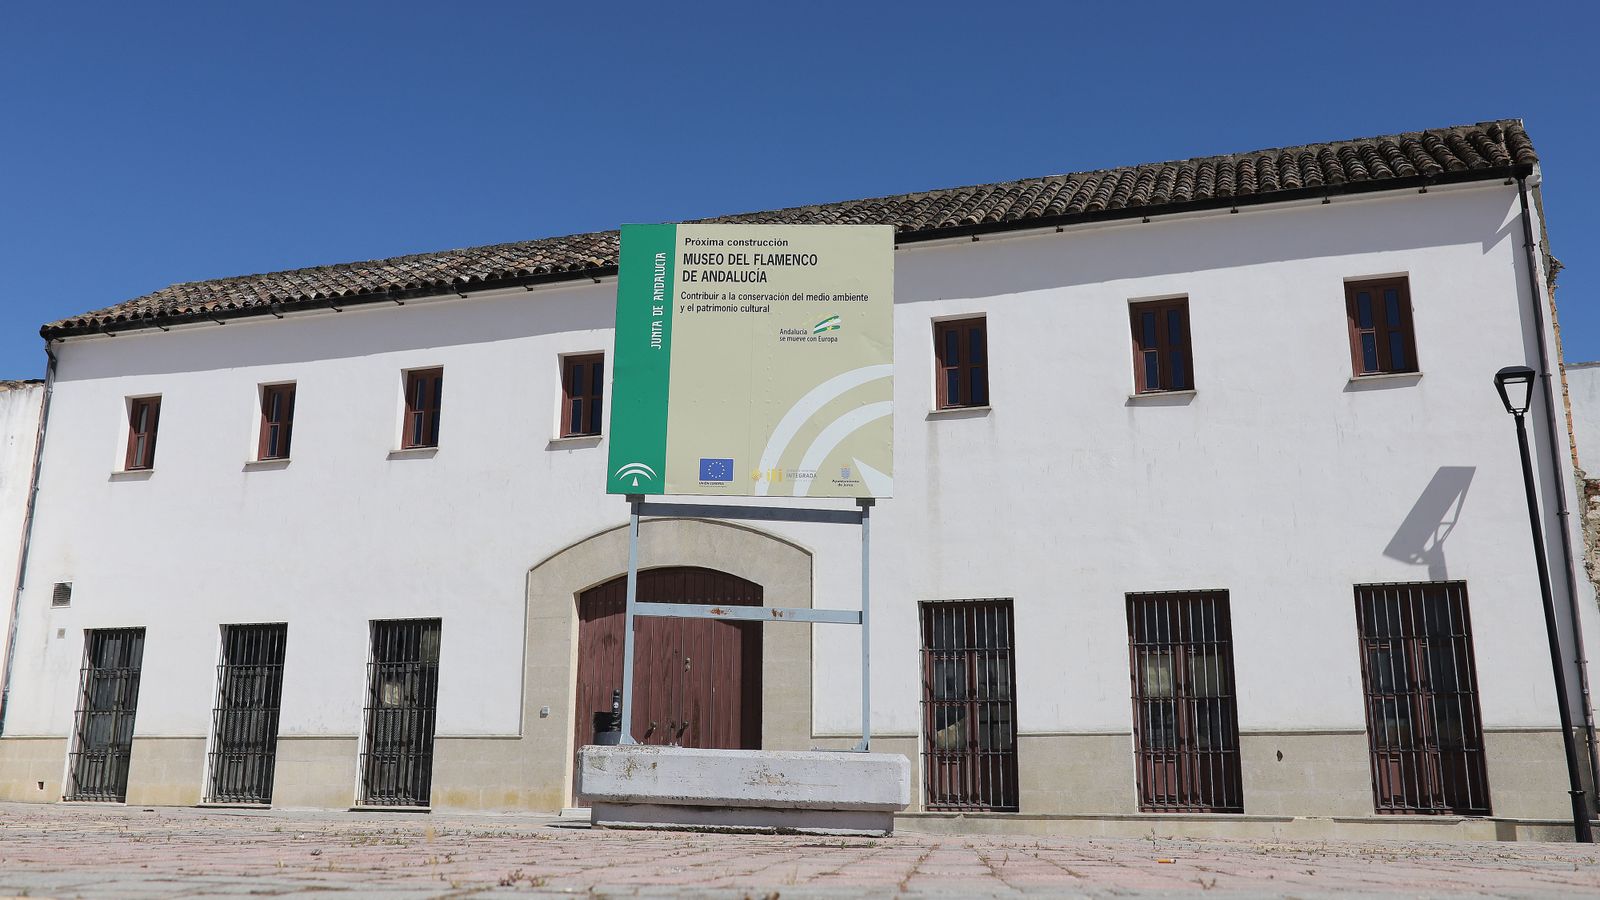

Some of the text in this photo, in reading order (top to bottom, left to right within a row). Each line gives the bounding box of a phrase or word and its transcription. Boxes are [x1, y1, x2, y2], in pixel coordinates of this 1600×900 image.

[685, 237, 789, 247] Próxima construcción
[683, 253, 818, 266] MUSEO DEL FLAMENCO
[682, 268, 767, 282] DE ANDALUCÍA
[680, 291, 719, 301] Contribuir
[729, 292, 736, 301] la
[738, 292, 790, 301] conservación
[791, 292, 804, 301] del
[806, 293, 831, 302] medio
[832, 293, 869, 302] ambiente
[652, 305, 664, 317] DE
[680, 304, 770, 314] y el patrimonio cultural
[651, 321, 663, 350] JUNTA
[818, 335, 838, 343] Europa
